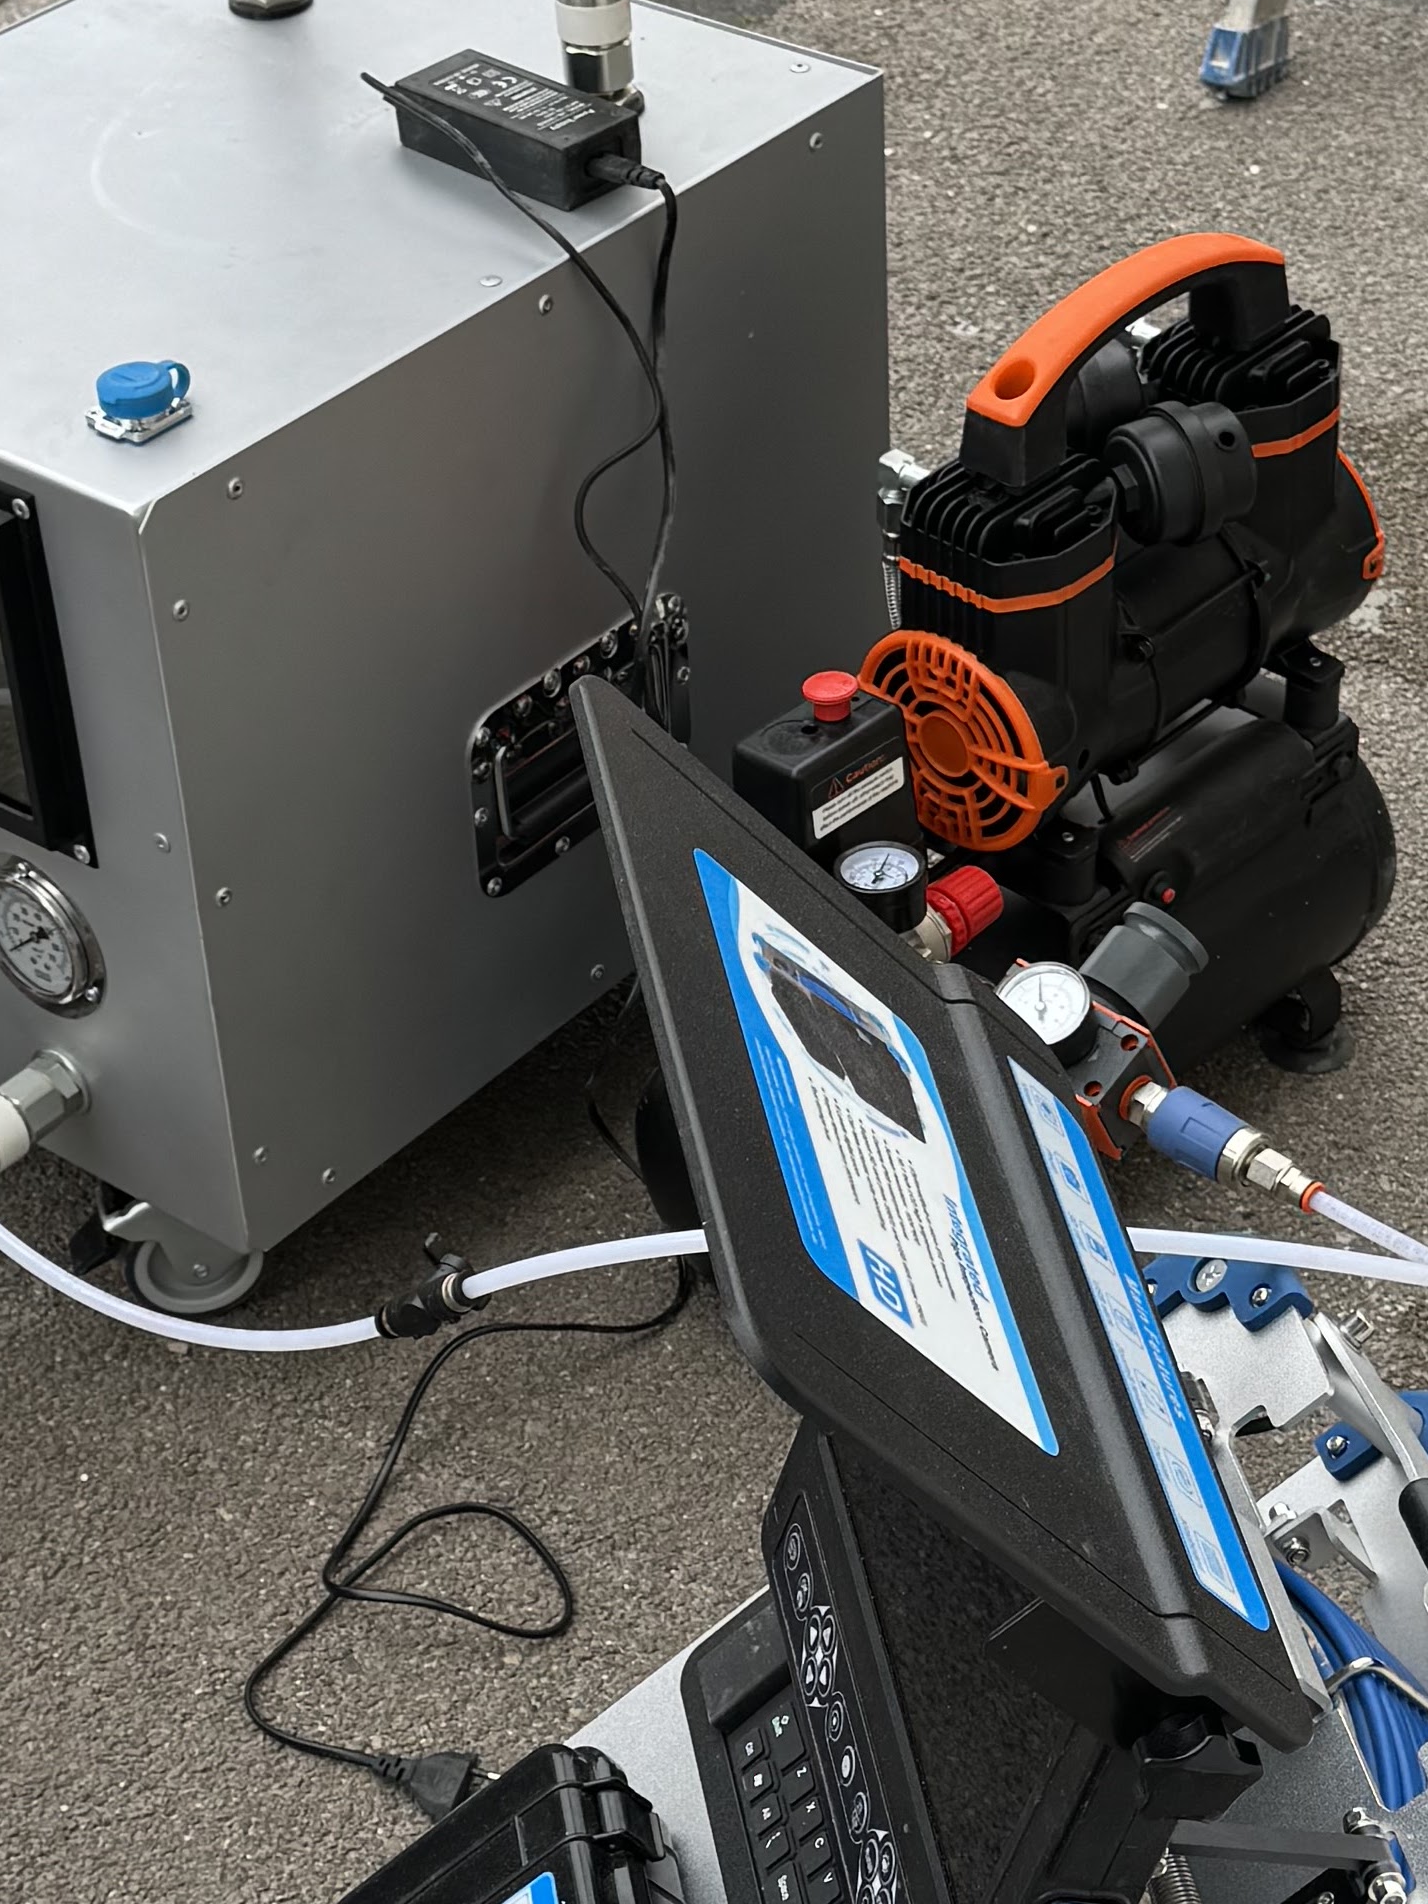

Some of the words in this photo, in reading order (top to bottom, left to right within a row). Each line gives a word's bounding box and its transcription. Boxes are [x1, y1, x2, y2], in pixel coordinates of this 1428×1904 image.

[943, 1193, 990, 1304] Integrated
[866, 1249, 903, 1314] HD
[979, 1324, 1000, 1373] Camera
[1123, 1272, 1150, 1325] Main
[1143, 1325, 1187, 1422] Features
[814, 1837, 825, 1849] C
[823, 1871, 834, 1884] V
